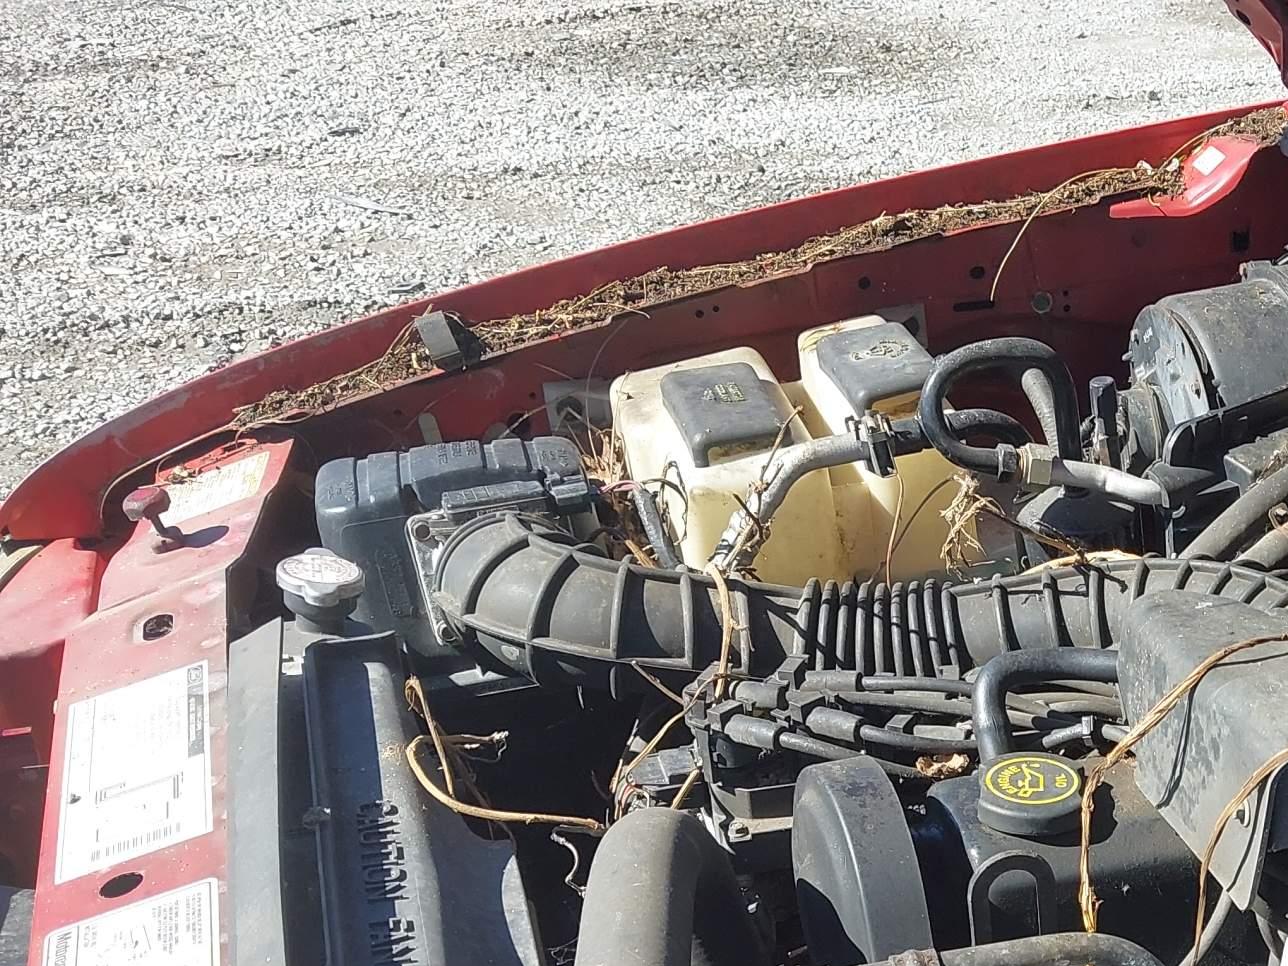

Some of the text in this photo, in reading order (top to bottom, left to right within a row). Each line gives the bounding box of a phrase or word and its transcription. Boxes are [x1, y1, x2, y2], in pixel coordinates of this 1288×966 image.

[998, 765, 1068, 794] ENGINE OIL
[357, 800, 410, 902] CAUTION
